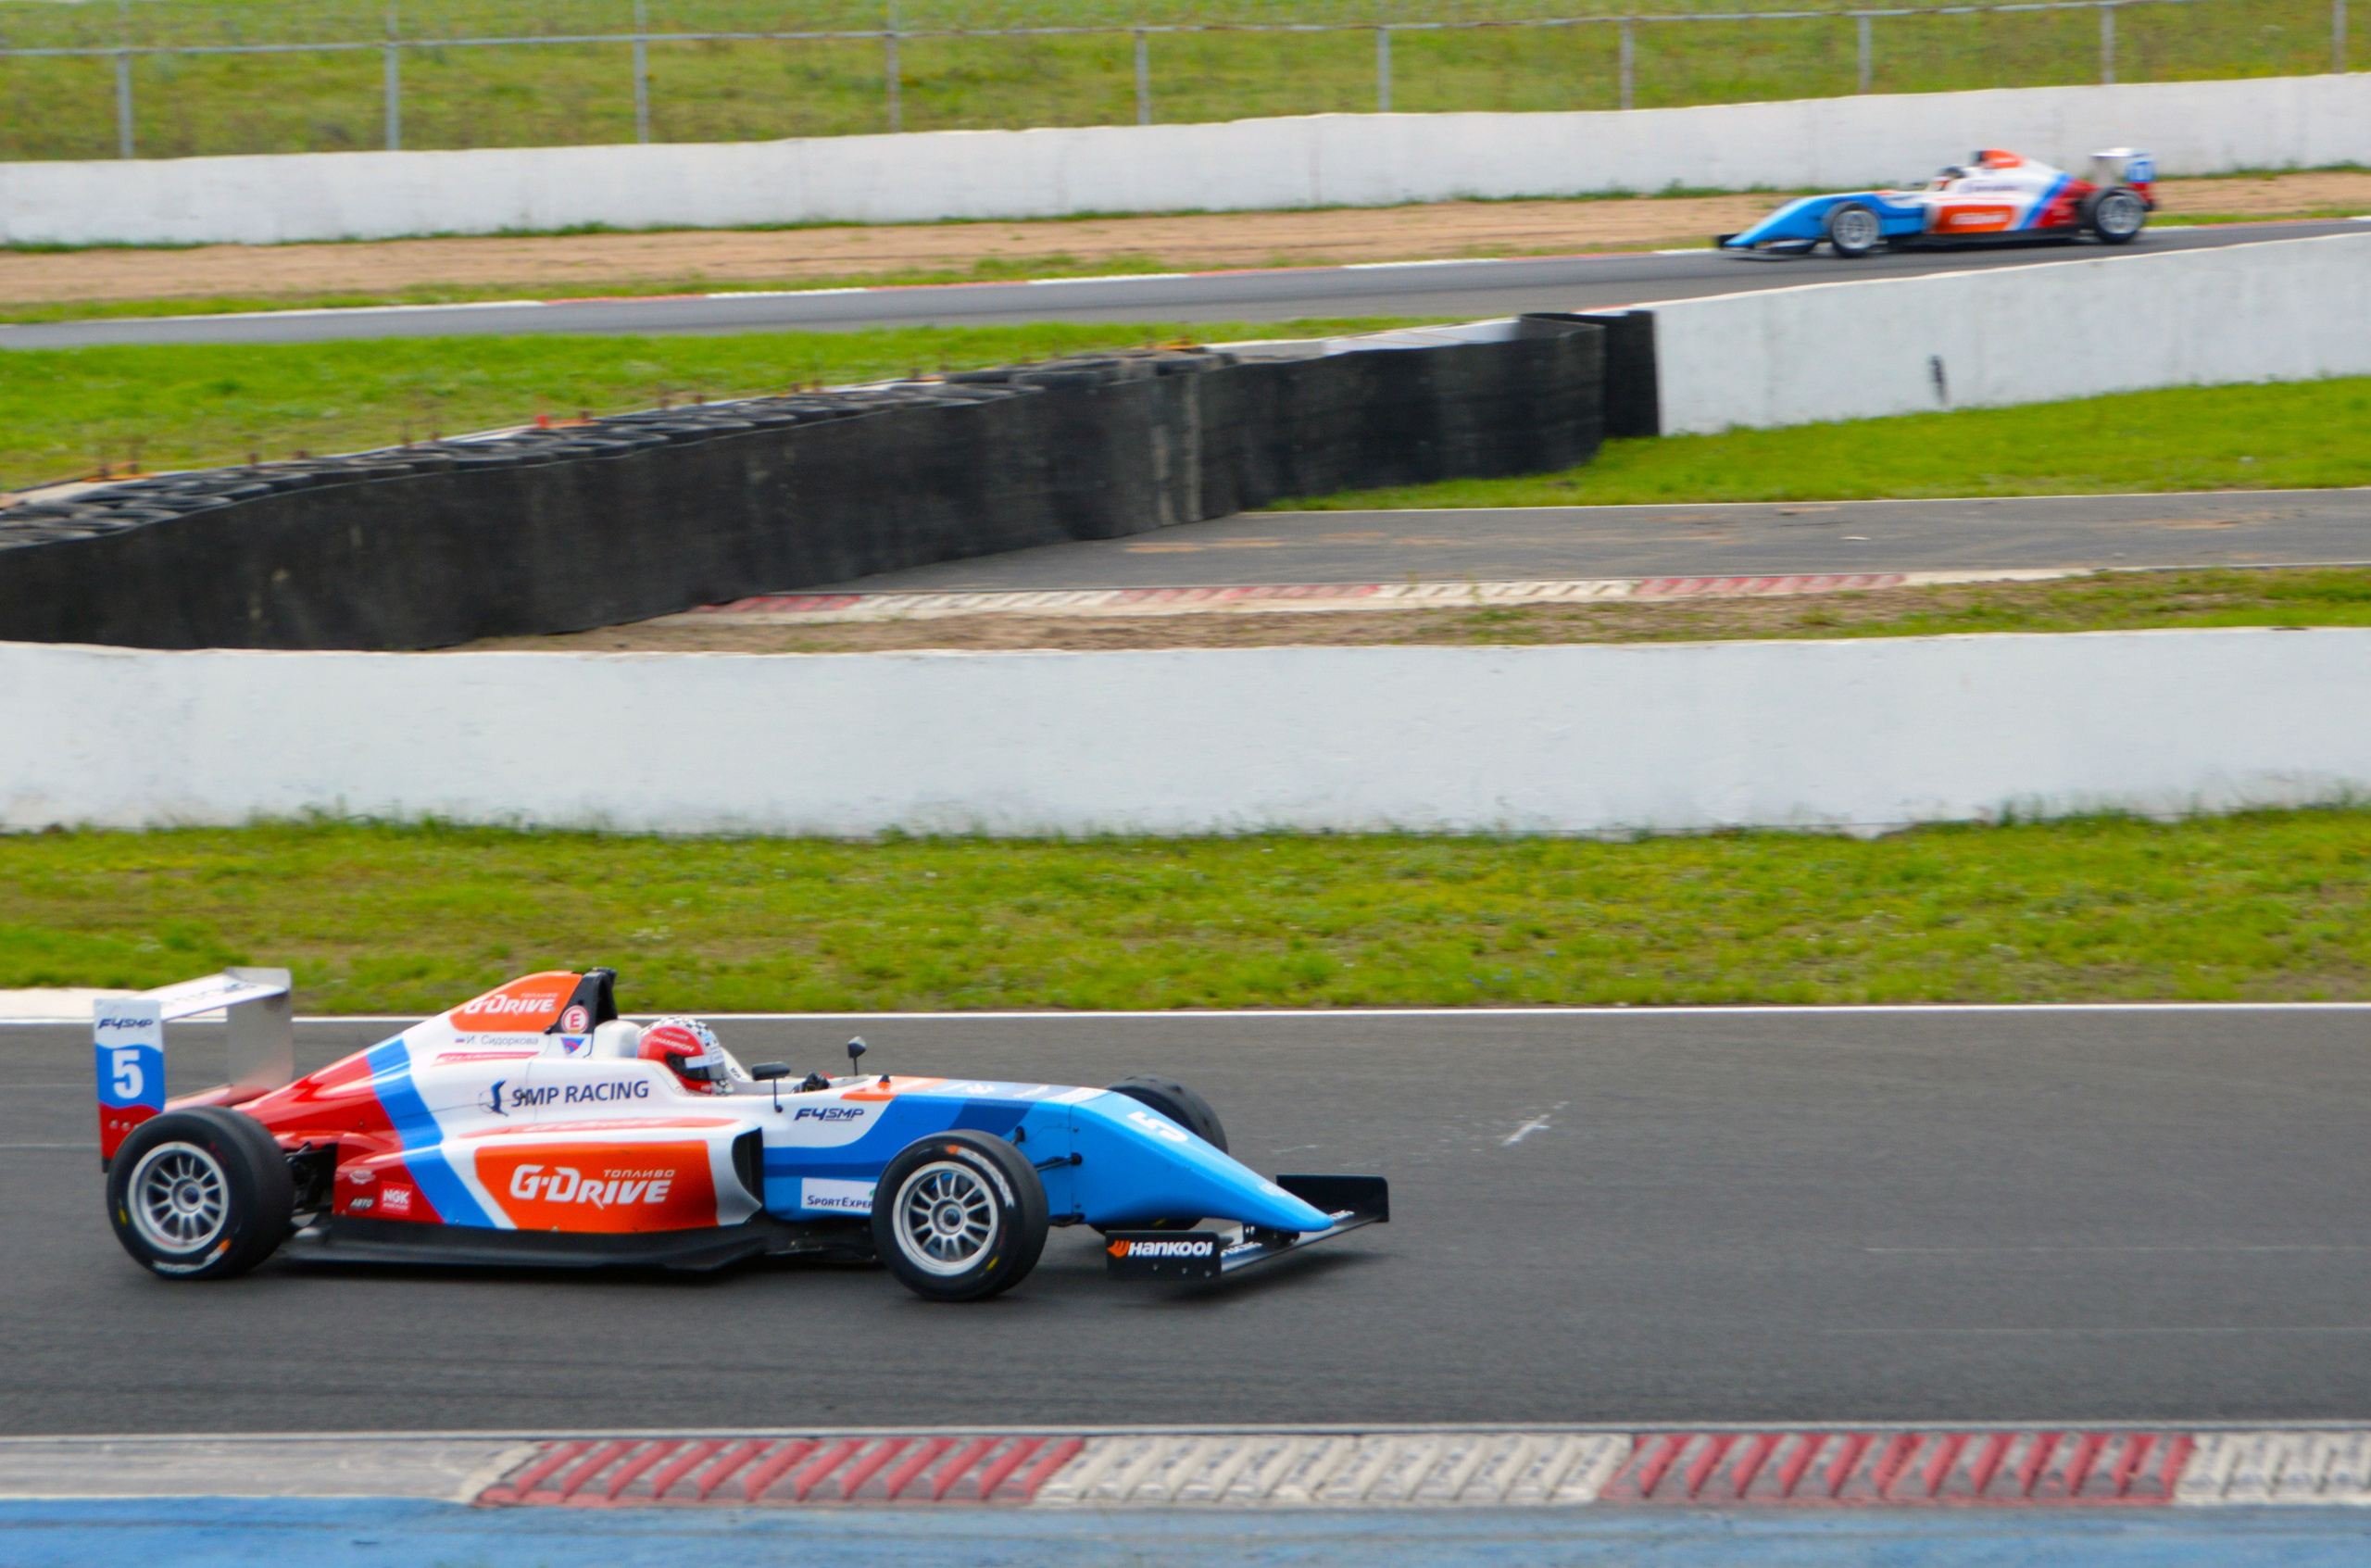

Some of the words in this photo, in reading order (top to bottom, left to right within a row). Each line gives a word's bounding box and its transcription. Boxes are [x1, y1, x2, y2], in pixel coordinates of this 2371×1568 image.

[570, 1012, 581, 1028] E
[111, 1048, 144, 1099] 5
[511, 1086, 559, 1108] SMP
[564, 1080, 649, 1104] RACING
[794, 1107, 865, 1122] F4SMP
[383, 1189, 410, 1205] NGK
